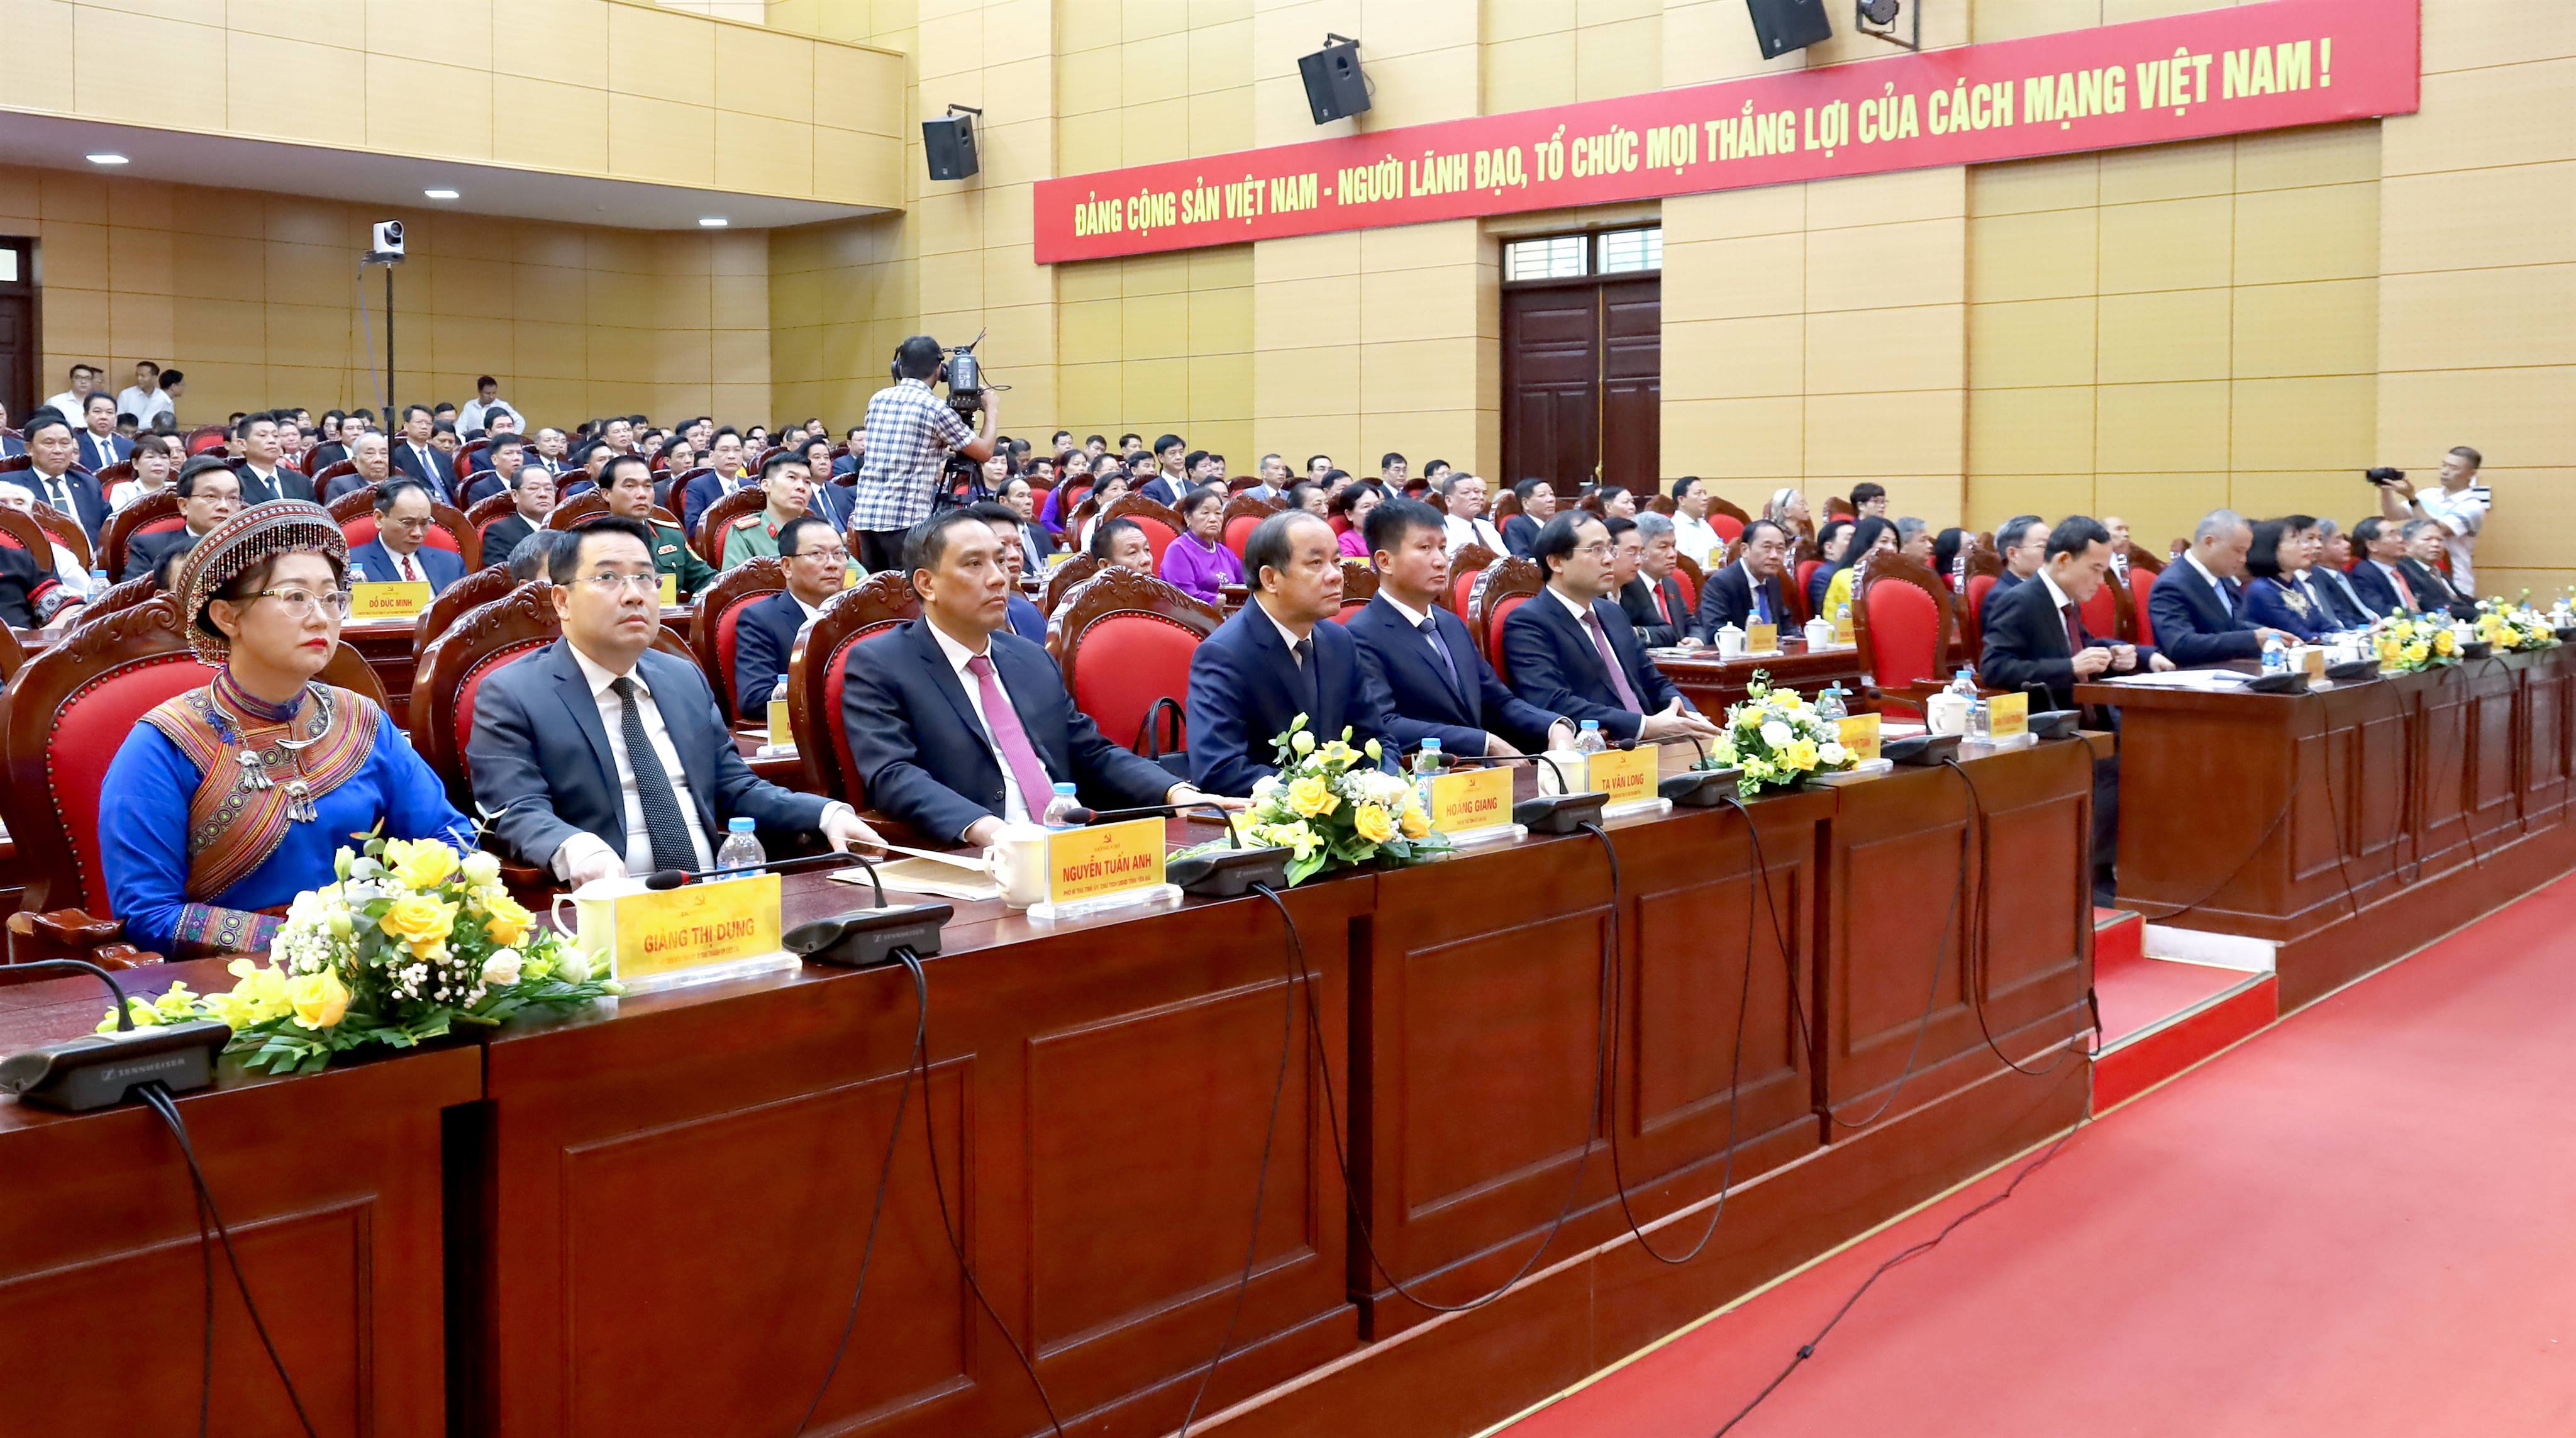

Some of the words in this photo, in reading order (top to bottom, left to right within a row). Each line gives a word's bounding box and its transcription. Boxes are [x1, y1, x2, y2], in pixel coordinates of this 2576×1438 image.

[1075, 191, 1122, 237] ĐẢNG
[1127, 187, 1176, 237] CỘNG
[1181, 176, 1219, 224] SẢN
[1224, 174, 1266, 225] VIỆT
[1271, 172, 1318, 213] NAM
[1338, 153, 1403, 205] NGƯỜI
[1410, 150, 1468, 197] LÃNH
[1474, 145, 1528, 196] ĐẠO,
[1534, 123, 1566, 182] TỔ
[1571, 124, 1638, 178] CHỨC
[1646, 123, 1697, 176] MỌI
[1704, 99, 1796, 162] THẮNG
[1804, 99, 1849, 158] LỢI
[1858, 81, 1919, 143] CỦA
[1928, 77, 2014, 135] CÁCH
[2024, 65, 2126, 130] MẠNG
[2136, 47, 2212, 116] VIỆT
[2223, 40, 2311, 99] NAM
[396, 598, 413, 607] MINH
[1612, 774, 1626, 789] VĂN
[1627, 773, 1644, 787] LONG
[1475, 796, 1497, 812] GIANG
[1063, 855, 1102, 883] NGUYỄN
[1104, 851, 1130, 875] TUẤN
[1132, 853, 1152, 870] ANH
[692, 925, 713, 947] THỊ
[118, 1058, 186, 1076] SENNHEISER
